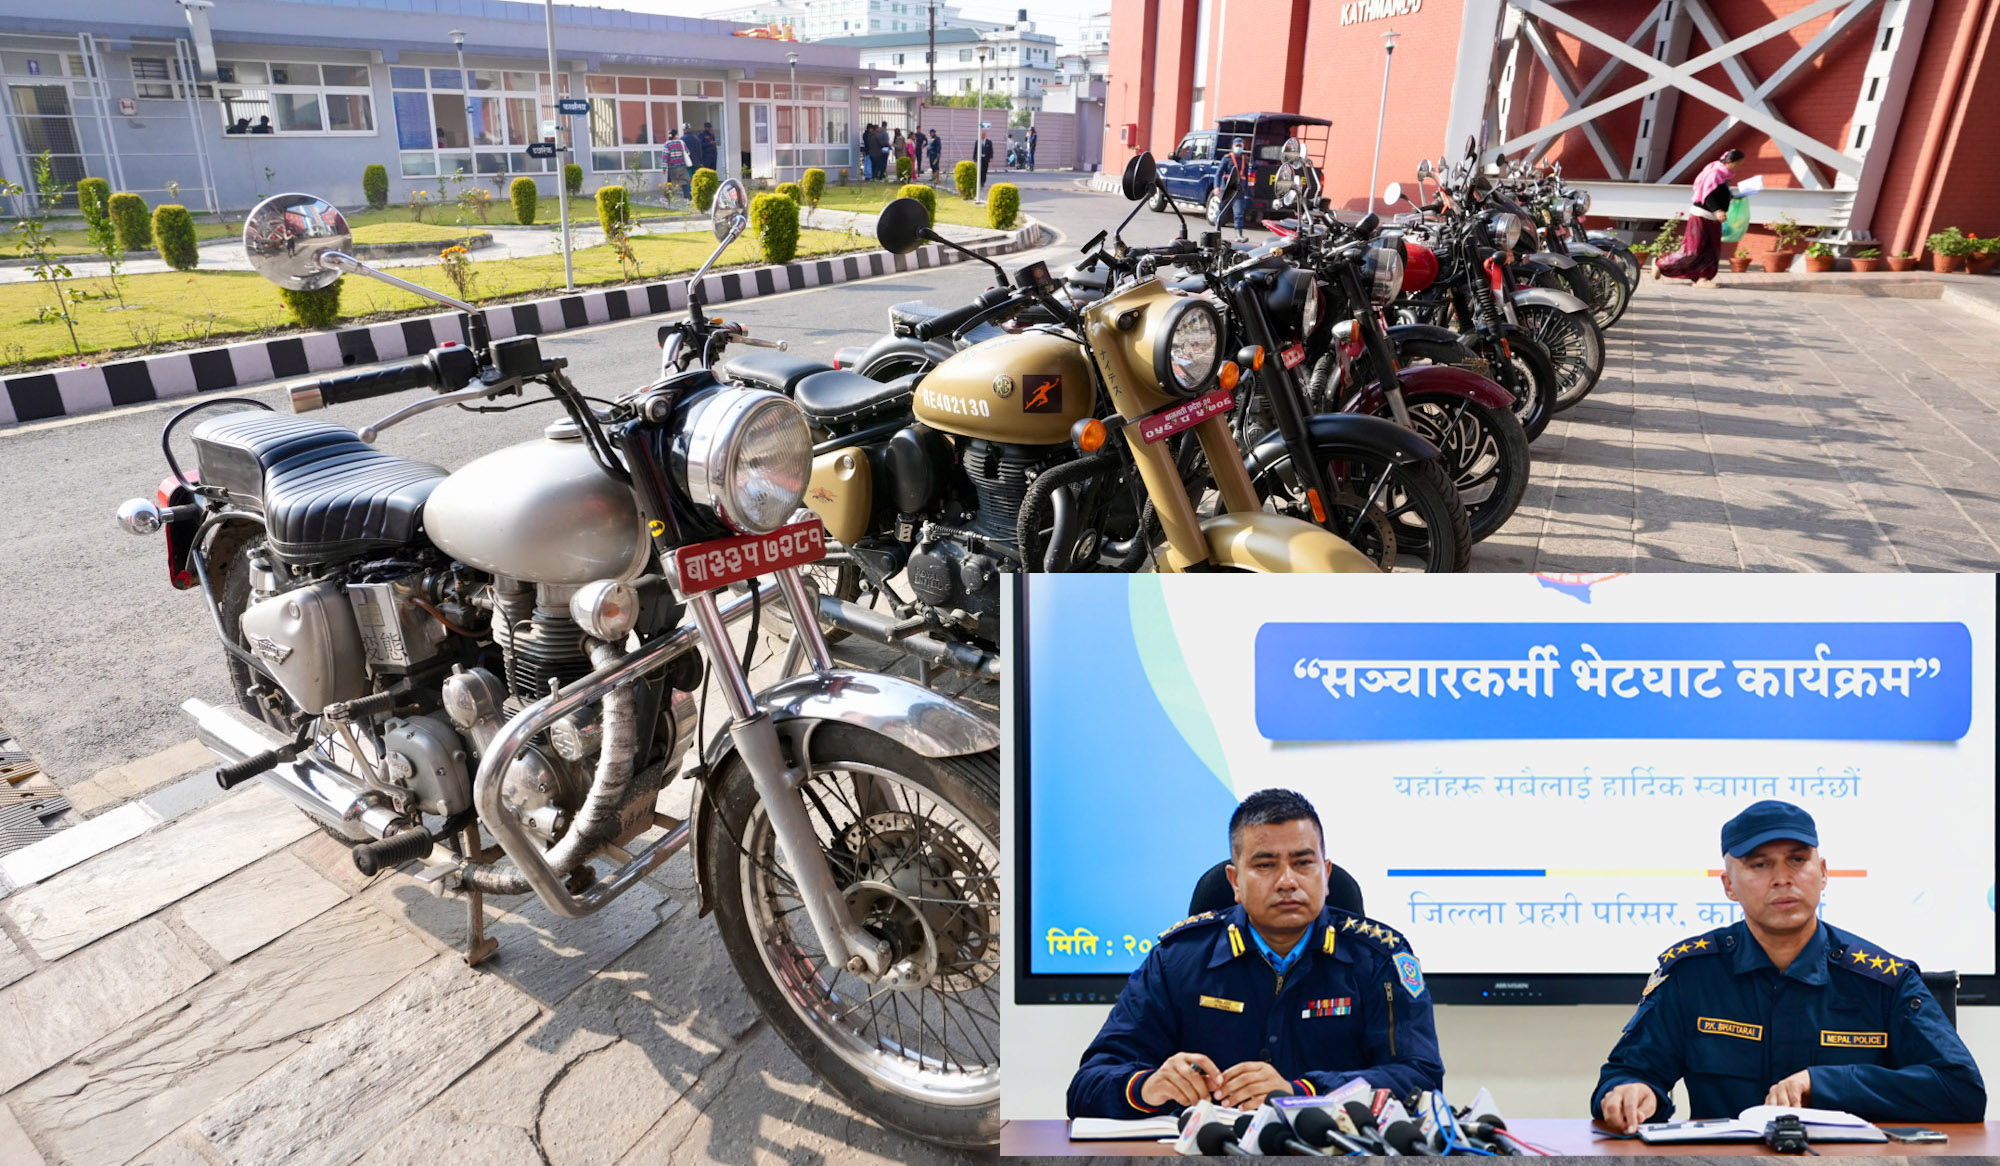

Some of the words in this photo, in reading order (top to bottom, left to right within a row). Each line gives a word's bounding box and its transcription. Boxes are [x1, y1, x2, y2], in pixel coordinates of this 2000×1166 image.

[1341, 0, 1422, 26] KATHMANDU
[922, 388, 990, 418] RE402130
[1570, 643, 1726, 699] भेटघाट
[1732, 643, 1941, 700] कार्यक्रम”
[1493, 766, 1593, 804] सबैलाई
[1600, 766, 1685, 799] हार्दिक
[1693, 776, 1780, 798] स्वागत
[1787, 766, 1862, 800] गर्दछौं
[1407, 891, 1507, 925] जिल्ला
[1515, 892, 1583, 928] प्रहरी
[1046, 927, 1100, 955] मिति
[1122, 934, 1156, 957] २०
[1718, 1022, 1755, 1036] BHATTARAI
[1826, 1034, 1852, 1044] NEPAL
[1853, 1035, 1882, 1045] POLICE
